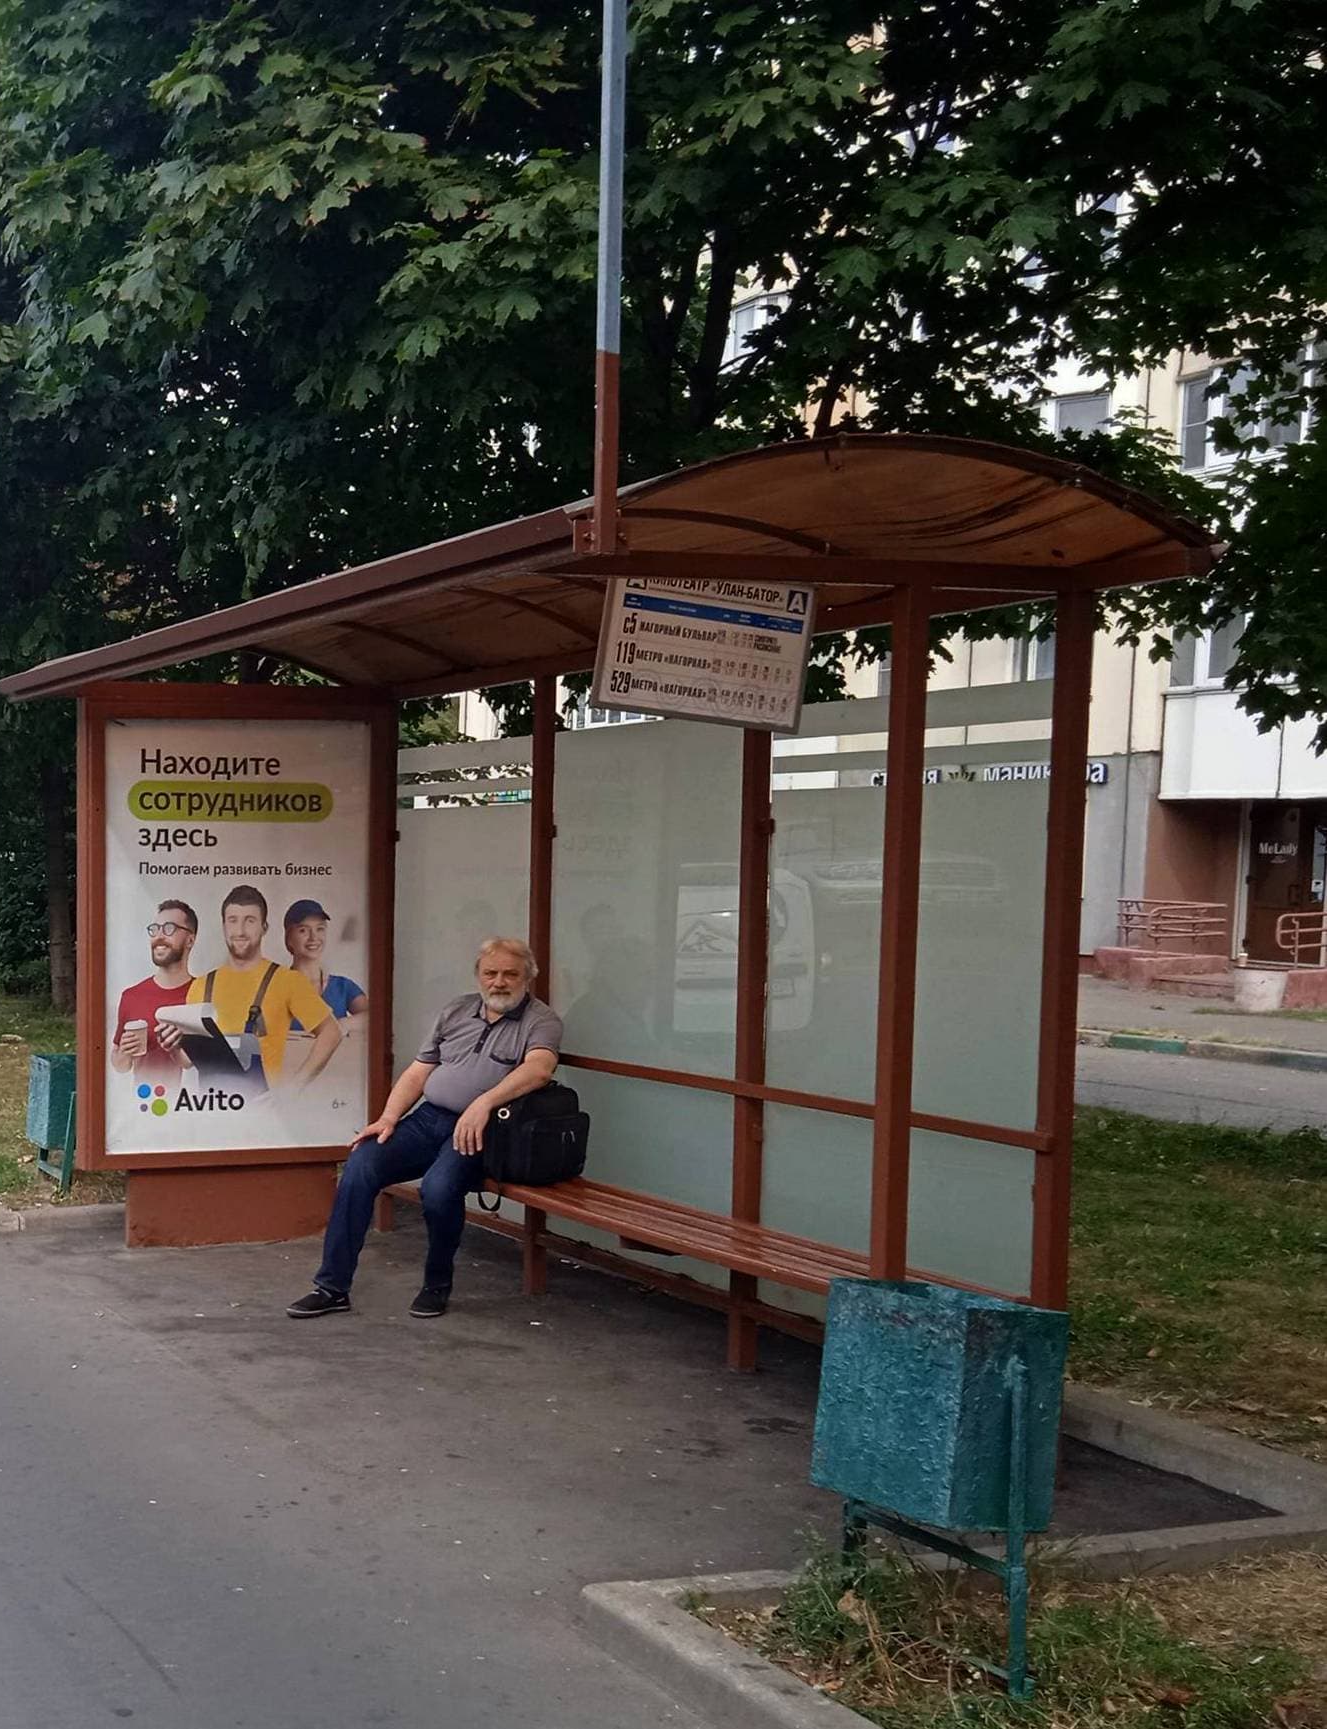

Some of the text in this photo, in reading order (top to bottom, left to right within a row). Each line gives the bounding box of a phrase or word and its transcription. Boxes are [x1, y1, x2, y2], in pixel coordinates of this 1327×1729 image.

[681, 625, 718, 642] БУЛЬВАР
[615, 640, 636, 665] 119
[636, 648, 663, 663] МЕТРО
[610, 669, 632, 694] 529
[631, 678, 658, 692] МЕТРО
[140, 749, 281, 780] Находите
[983, 761, 1108, 785] маника
[138, 790, 323, 816] сотрудников
[138, 828, 219, 851] здесь
[139, 861, 333, 878] Помогаем развивать бизнес
[174, 1088, 244, 1112] Avito
[331, 1098, 348, 1110] 6+
